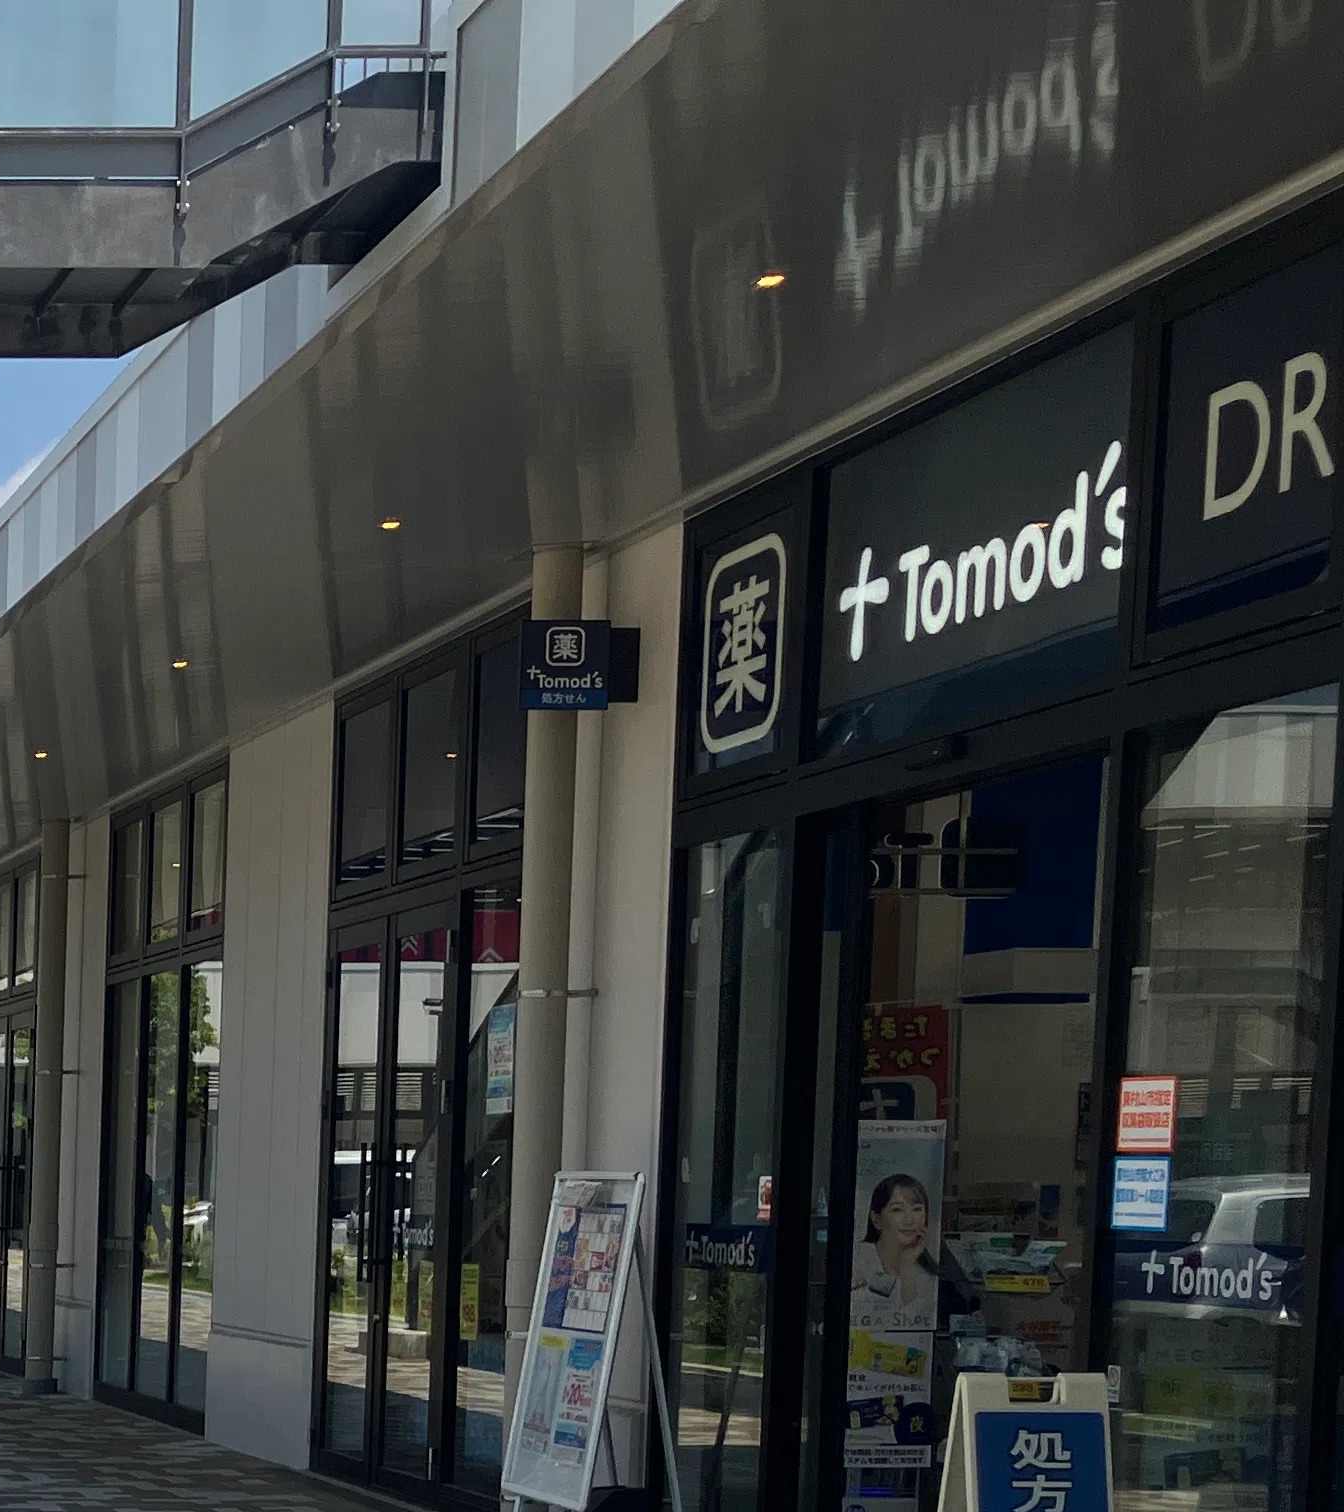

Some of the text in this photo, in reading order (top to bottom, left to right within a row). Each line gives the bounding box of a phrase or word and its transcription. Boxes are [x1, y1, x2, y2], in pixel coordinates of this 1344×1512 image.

[897, 438, 1128, 643] Tomod's
[552, 632, 579, 660] 薬
[713, 574, 771, 719] 薬
[536, 670, 604, 689] Tomod's
[541, 692, 587, 705] 処方せん
[1168, 1251, 1274, 1301] Tomod's
